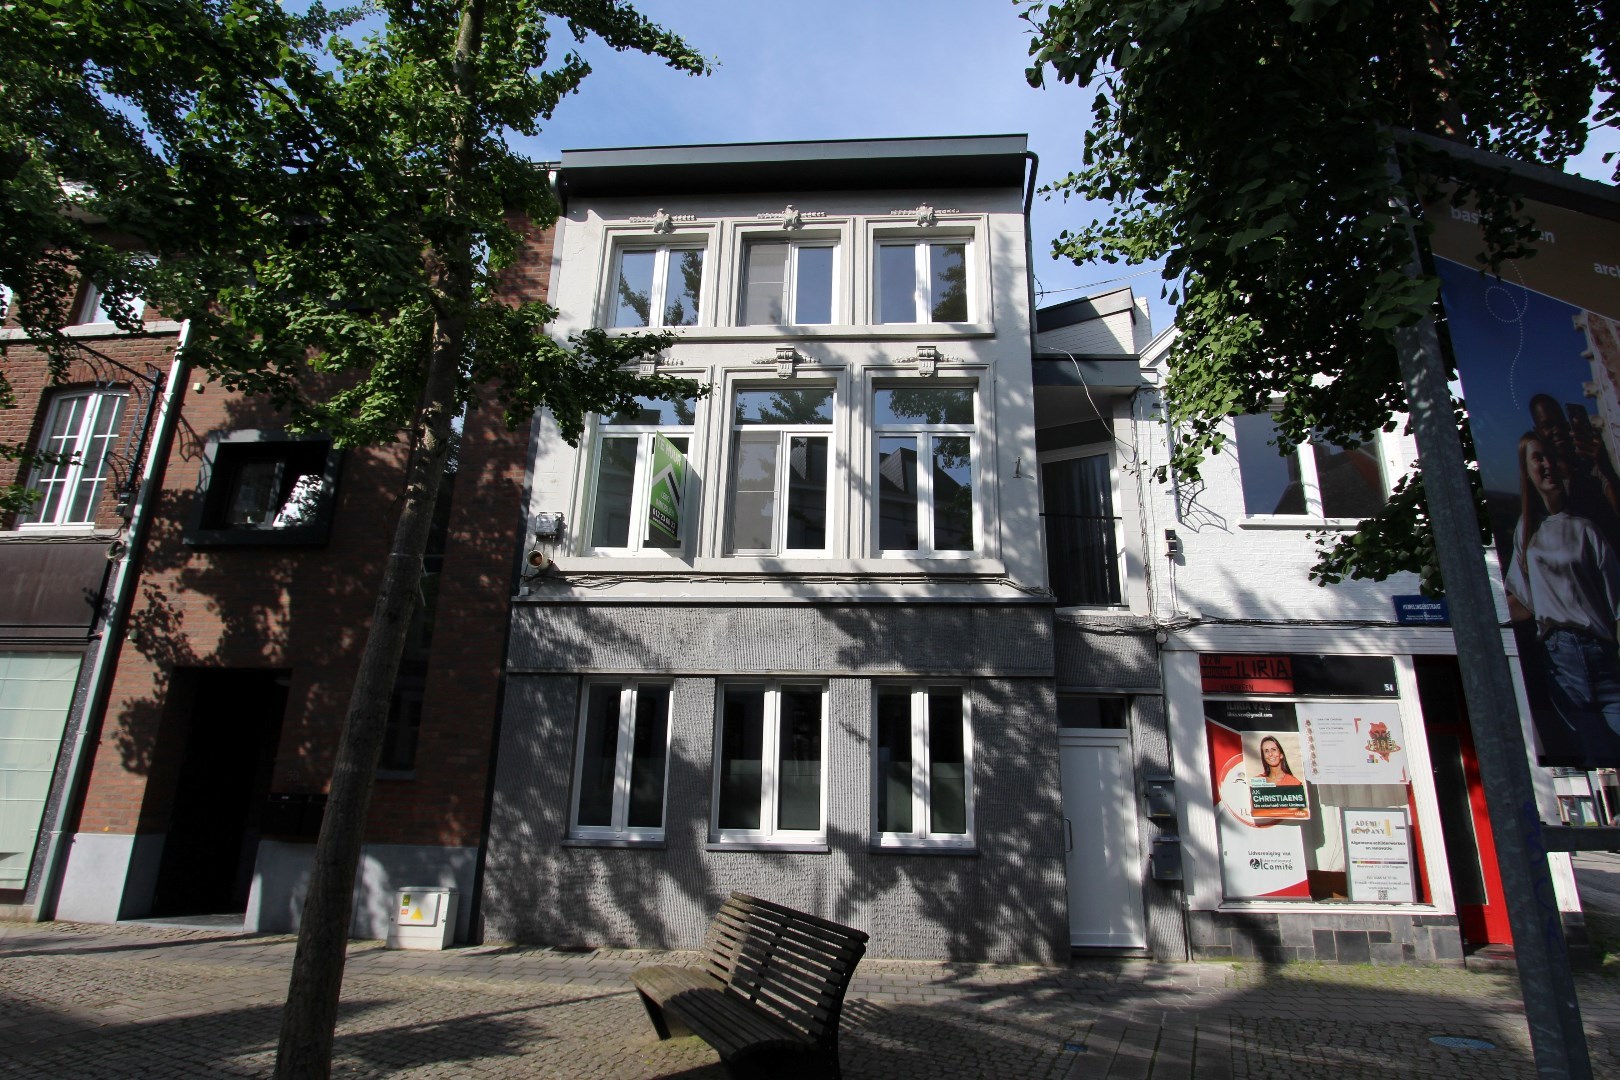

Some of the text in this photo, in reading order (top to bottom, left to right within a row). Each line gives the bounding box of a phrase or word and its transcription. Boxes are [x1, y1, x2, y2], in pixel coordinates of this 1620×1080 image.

[656, 436, 682, 466] TE HUUR
[1236, 659, 1290, 678] ILIRIA
[1263, 862, 1293, 870] Comité
